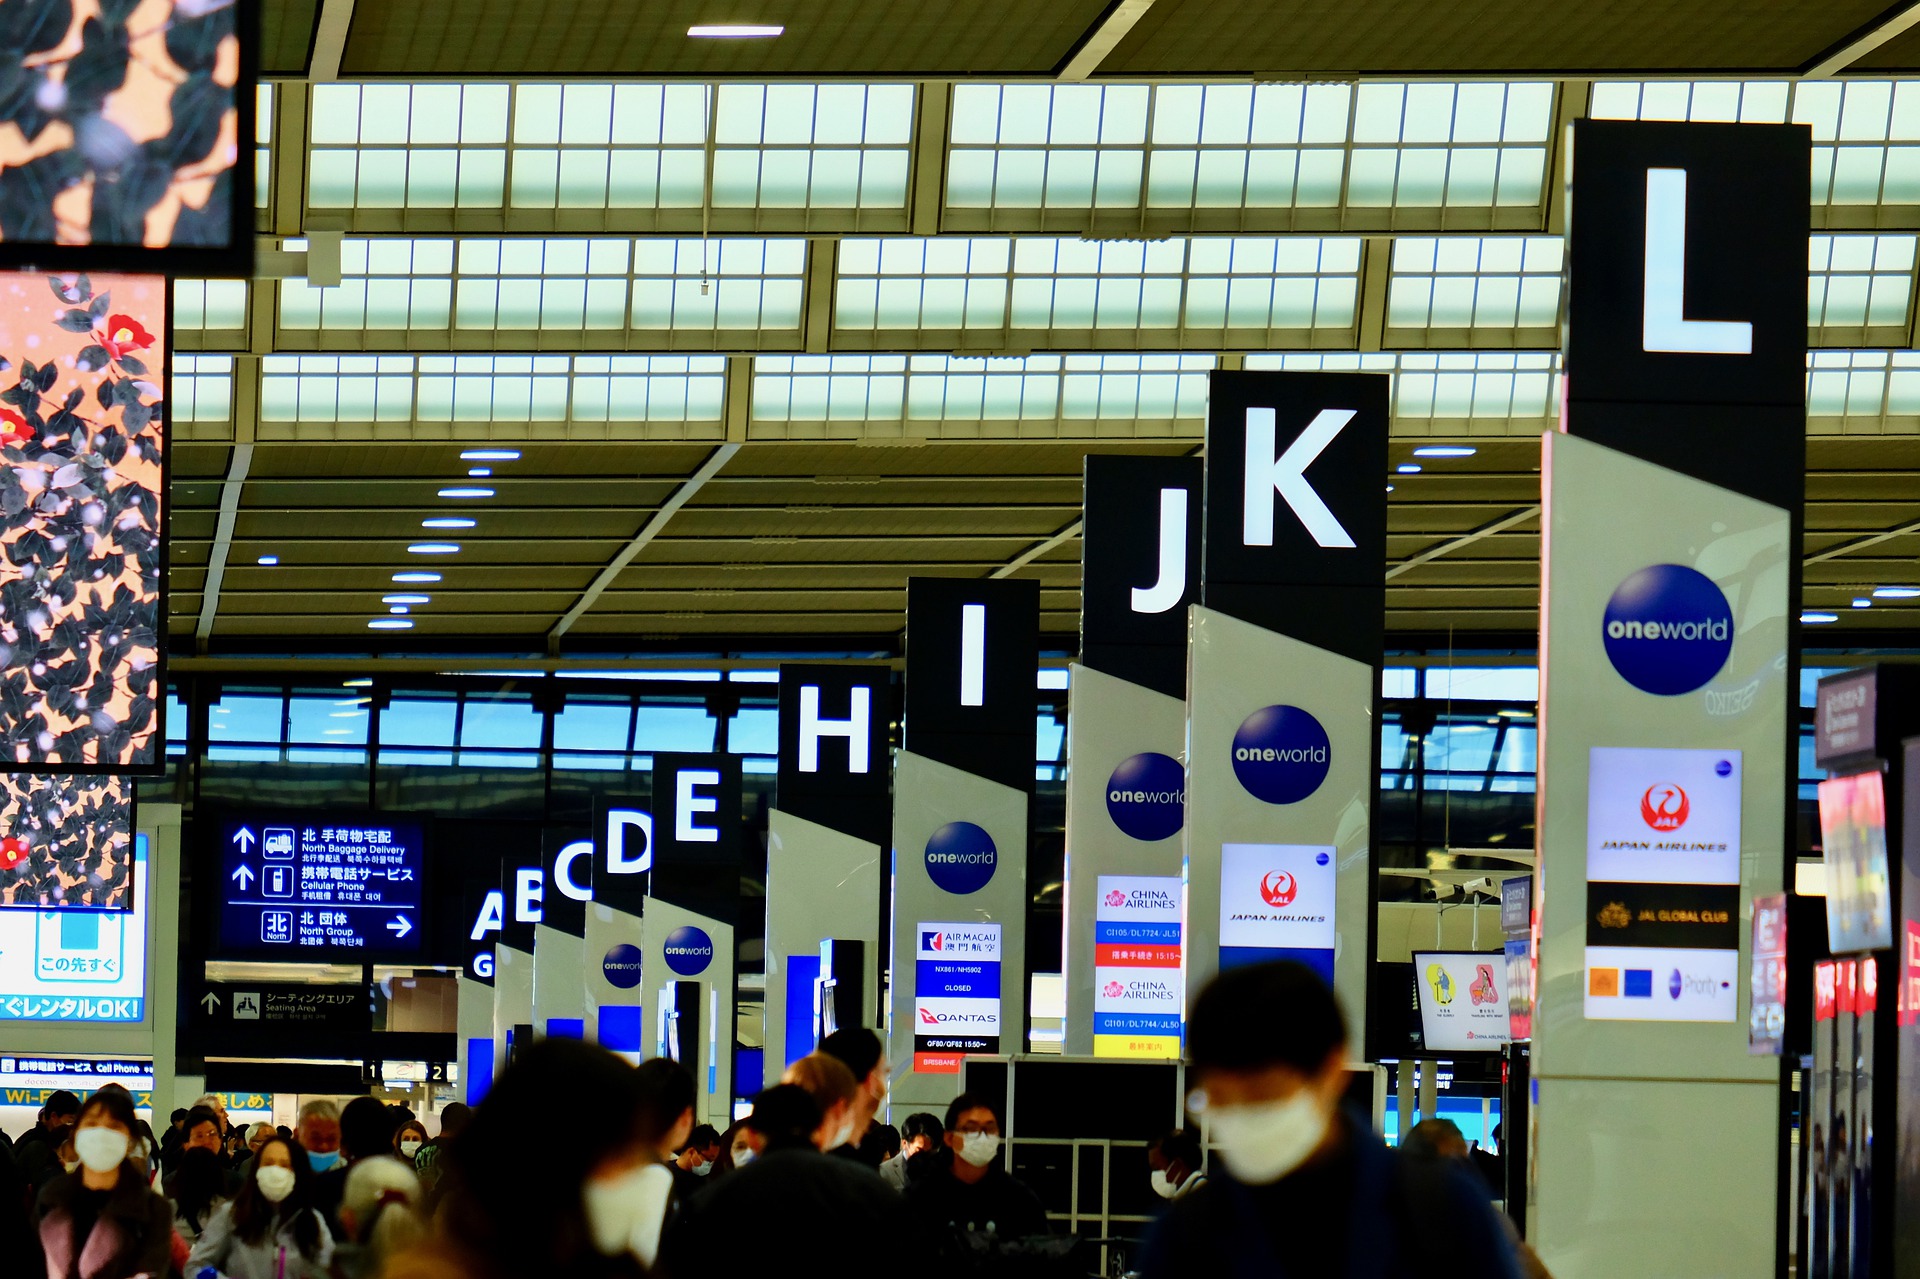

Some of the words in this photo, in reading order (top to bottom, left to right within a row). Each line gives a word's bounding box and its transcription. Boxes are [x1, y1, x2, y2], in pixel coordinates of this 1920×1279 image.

[1643, 169, 1753, 354] L
[1243, 408, 1357, 547] K
[1132, 489, 1188, 614] J
[1607, 617, 1728, 641] oneworld
[960, 604, 984, 707] I
[799, 686, 870, 773] H
[1235, 746, 1326, 763] oneworld
[676, 770, 718, 841] E
[1653, 816, 1679, 827] JAL
[302, 828, 316, 842] 北
[321, 829, 391, 844] 手荷物宅配
[607, 810, 651, 874] D
[302, 844, 326, 853] North
[328, 845, 367, 855] Baggage
[369, 845, 405, 856] Delivery
[1601, 840, 1650, 850] JAPAN
[1655, 842, 1728, 853] AIRLINES
[927, 851, 994, 865] oneworld
[301, 866, 413, 882] 携帯電話サービス
[555, 842, 593, 901] C
[301, 881, 335, 890] Cellular
[337, 882, 365, 891] Phone
[516, 869, 542, 921] B
[1131, 890, 1169, 900] CHINA
[1270, 896, 1290, 904] JAL
[1125, 899, 1176, 909] AIRLINES
[300, 911, 314, 926] 北
[319, 912, 347, 926] 団体
[471, 891, 502, 940] A
[1638, 910, 1656, 921] JAL
[1658, 910, 1699, 922] GLOBAL
[1701, 910, 1729, 923] CLUB
[267, 913, 287, 933] 北
[267, 932, 287, 940] North
[300, 927, 324, 936] North
[326, 928, 353, 938] Group
[945, 933, 961, 941] AIR
[963, 933, 996, 941] MACAU
[665, 946, 711, 955] oneworld
[42, 957, 116, 972] この先すぐ
[473, 955, 492, 976] G
[1129, 981, 1167, 991] CHINA
[1685, 975, 1718, 998] Priority
[267, 993, 355, 1004] シーティングエリア
[1123, 990, 1174, 1000] AIRLINES
[0, 997, 139, 1018] ぐレンタルOK!
[265, 1003, 295, 1013] Seating
[297, 1004, 316, 1012] Area
[937, 1013, 997, 1022] QANTAS
[1129, 1042, 1163, 1051] 最終案内
[96, 1063, 112, 1073] Cell
[113, 1064, 140, 1073] Phone
[369, 1064, 376, 1078] 1
[432, 1065, 442, 1080] 2
[24, 1078, 58, 1086] docomo
